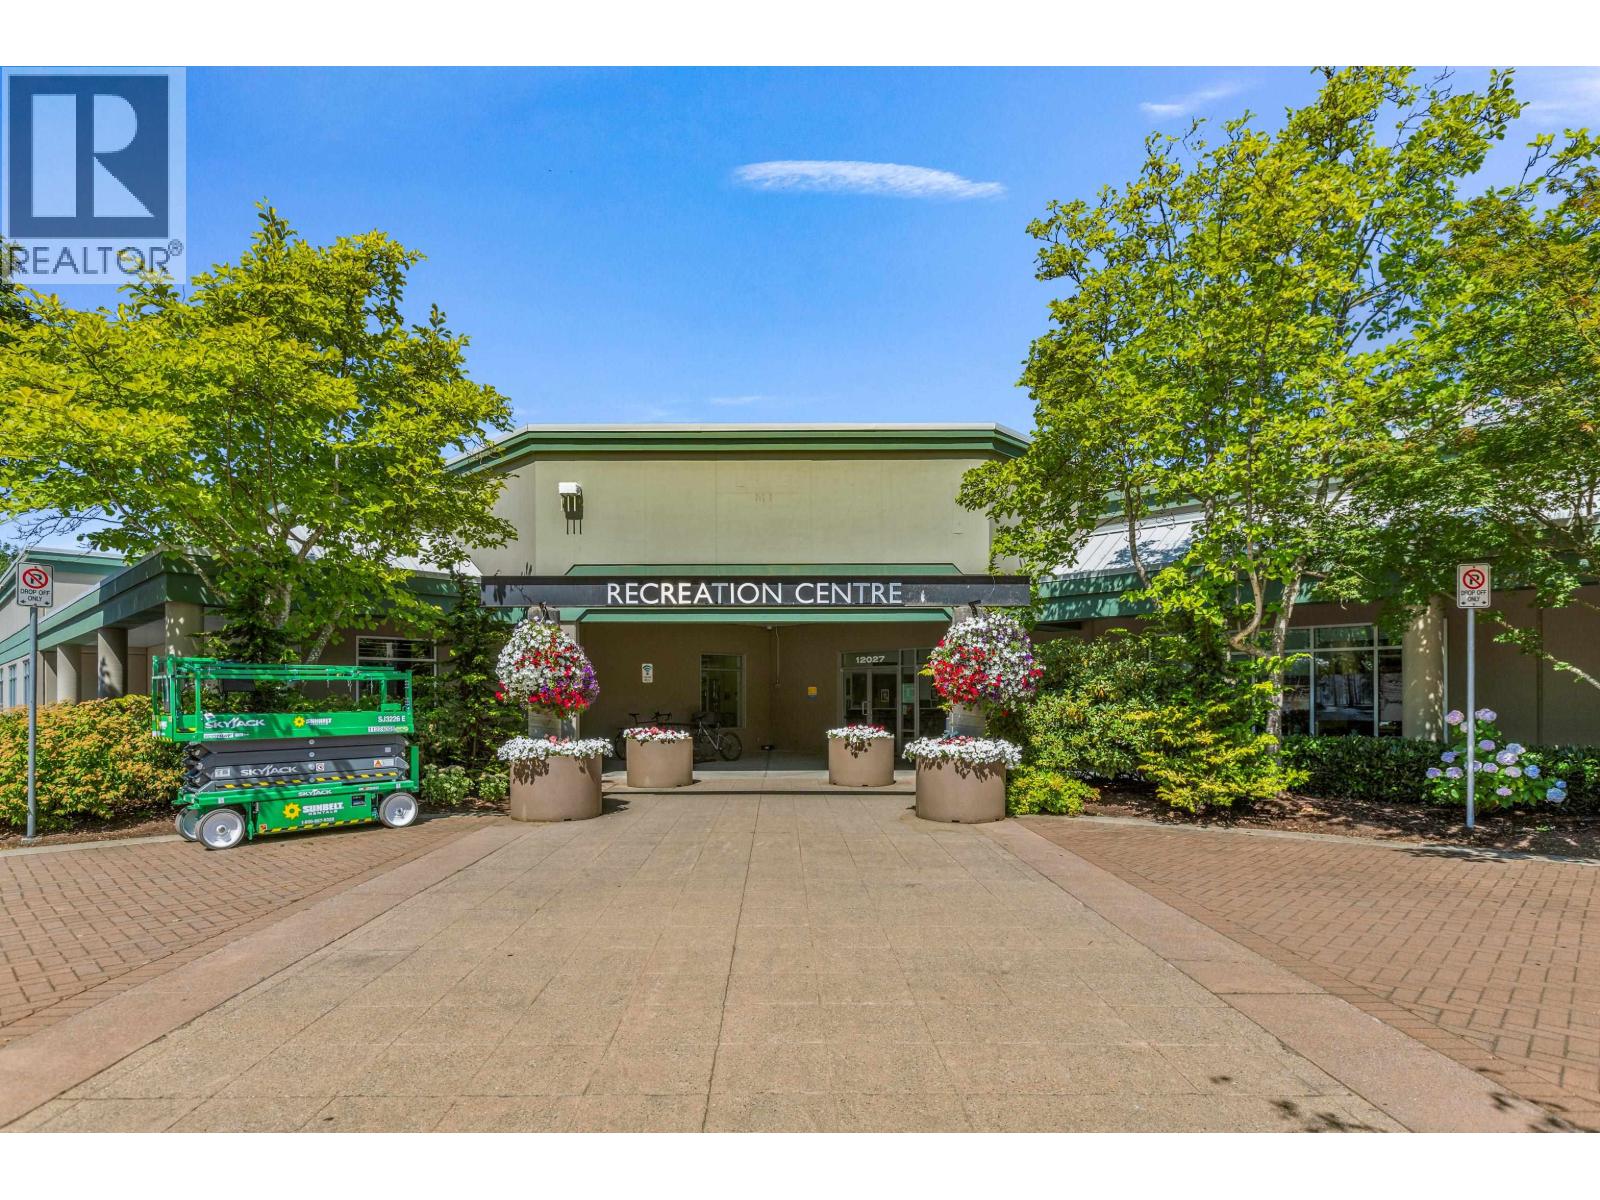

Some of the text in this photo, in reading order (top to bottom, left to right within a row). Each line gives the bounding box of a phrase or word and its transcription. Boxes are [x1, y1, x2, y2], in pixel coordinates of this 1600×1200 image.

[607, 582, 902, 605] RECREATION CENTRE
[855, 655, 886, 664] 12027
[204, 717, 266, 729] SKYJACK
[240, 763, 299, 777] SKYJACK
[297, 788, 333, 797] SKYJACK
[302, 801, 345, 814] SUNBELT
